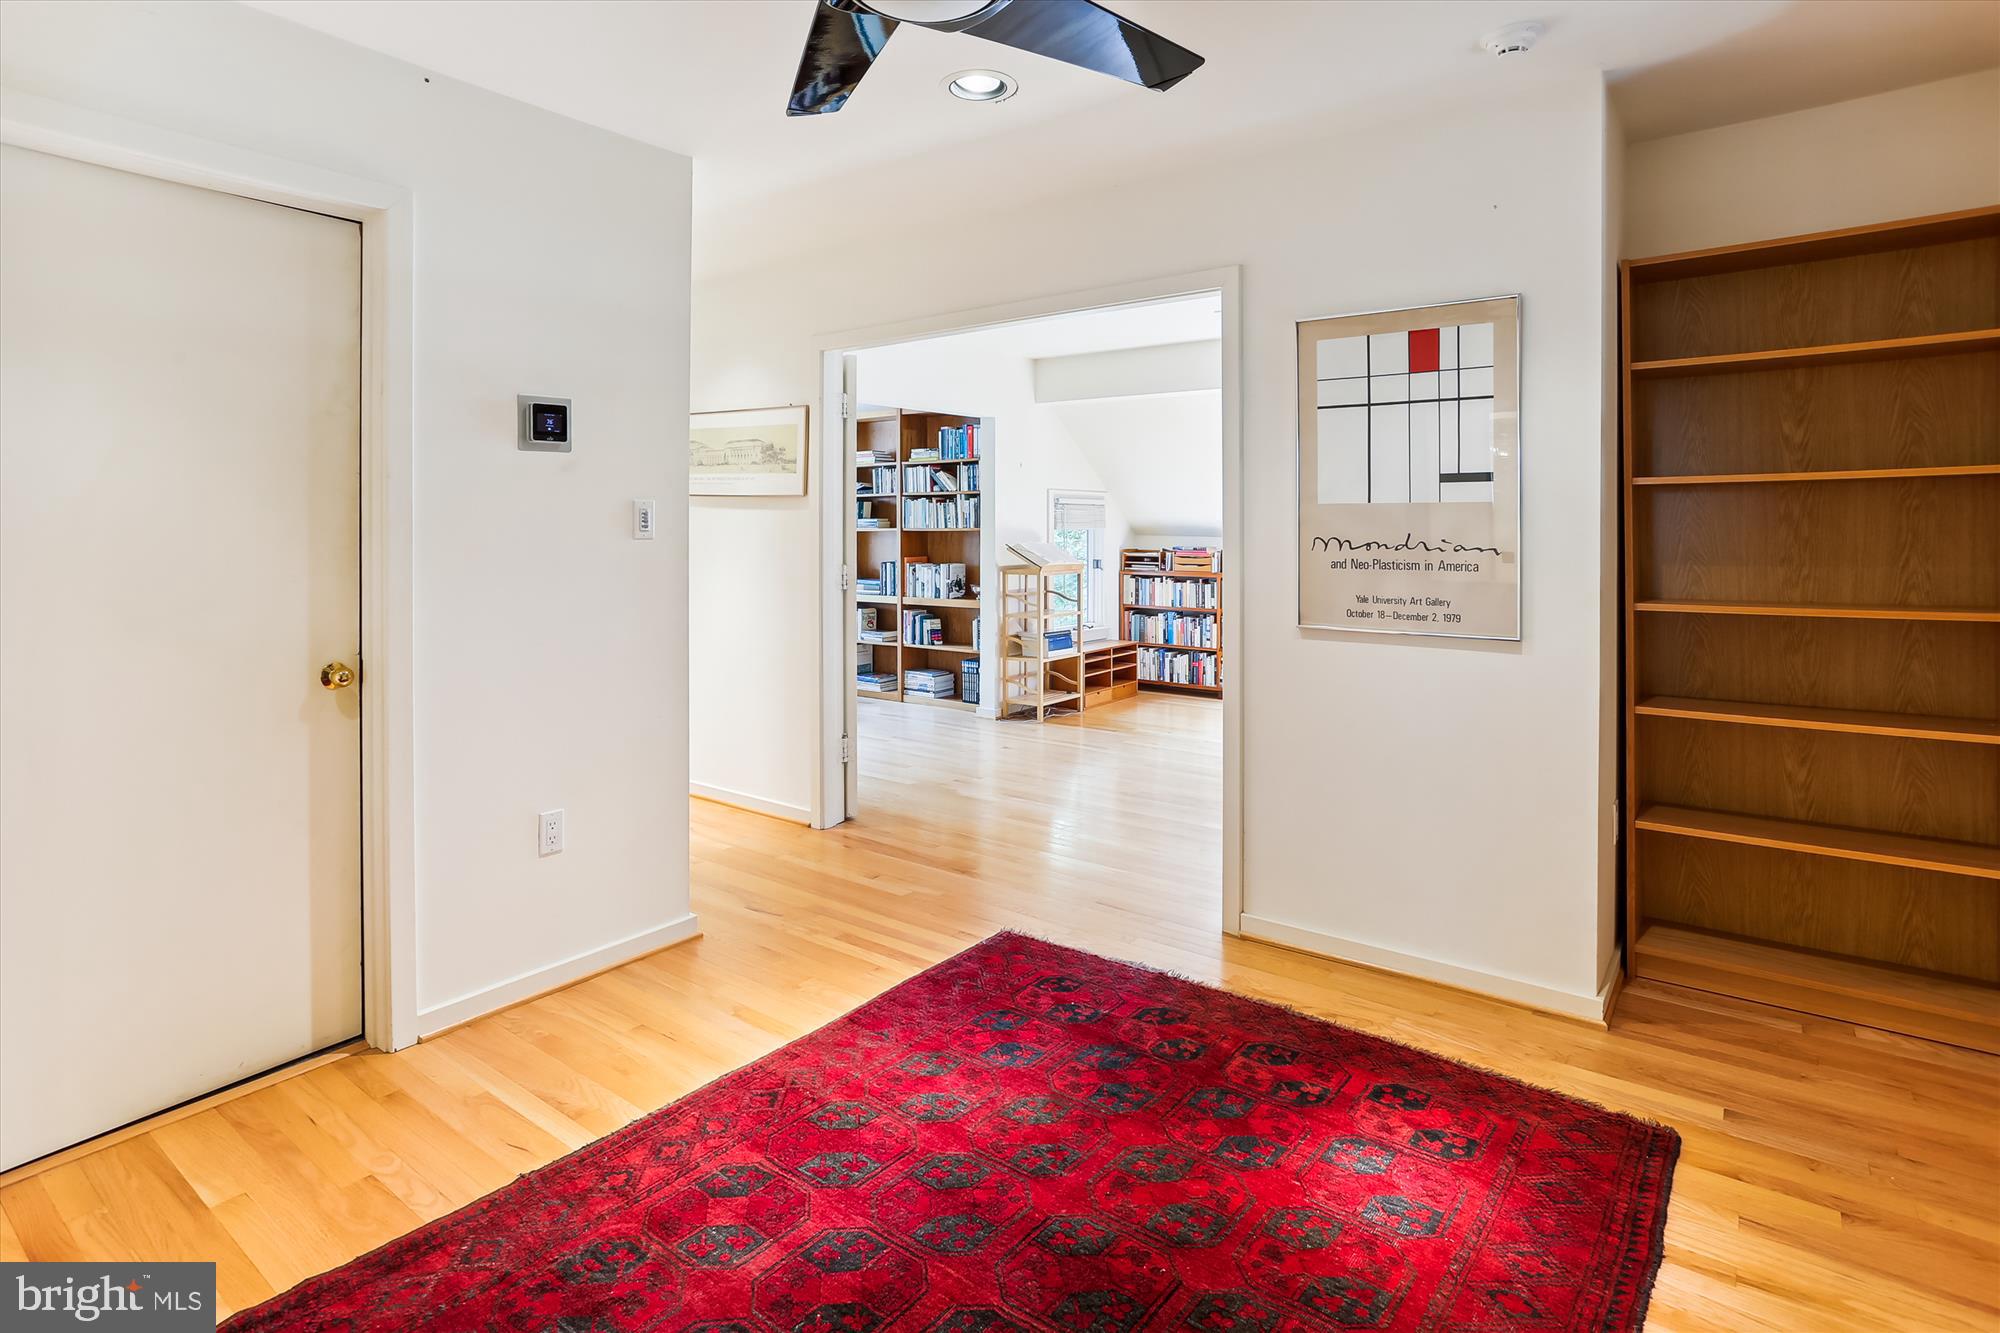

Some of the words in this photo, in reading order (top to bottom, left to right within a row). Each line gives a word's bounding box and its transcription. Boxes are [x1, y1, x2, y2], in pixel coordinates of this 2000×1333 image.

[1330, 558, 1347, 571] and
[1350, 558, 1421, 572] Neo-Plasticism
[1424, 560, 1434, 572] in
[1437, 560, 1480, 573] America
[1355, 594, 1370, 604] Yale
[1372, 595, 1407, 607] University
[1409, 596, 1423, 606] Art
[1425, 597, 1452, 609] Gallery
[1346, 608, 1374, 619] October
[1443, 613, 1462, 624] 1979
